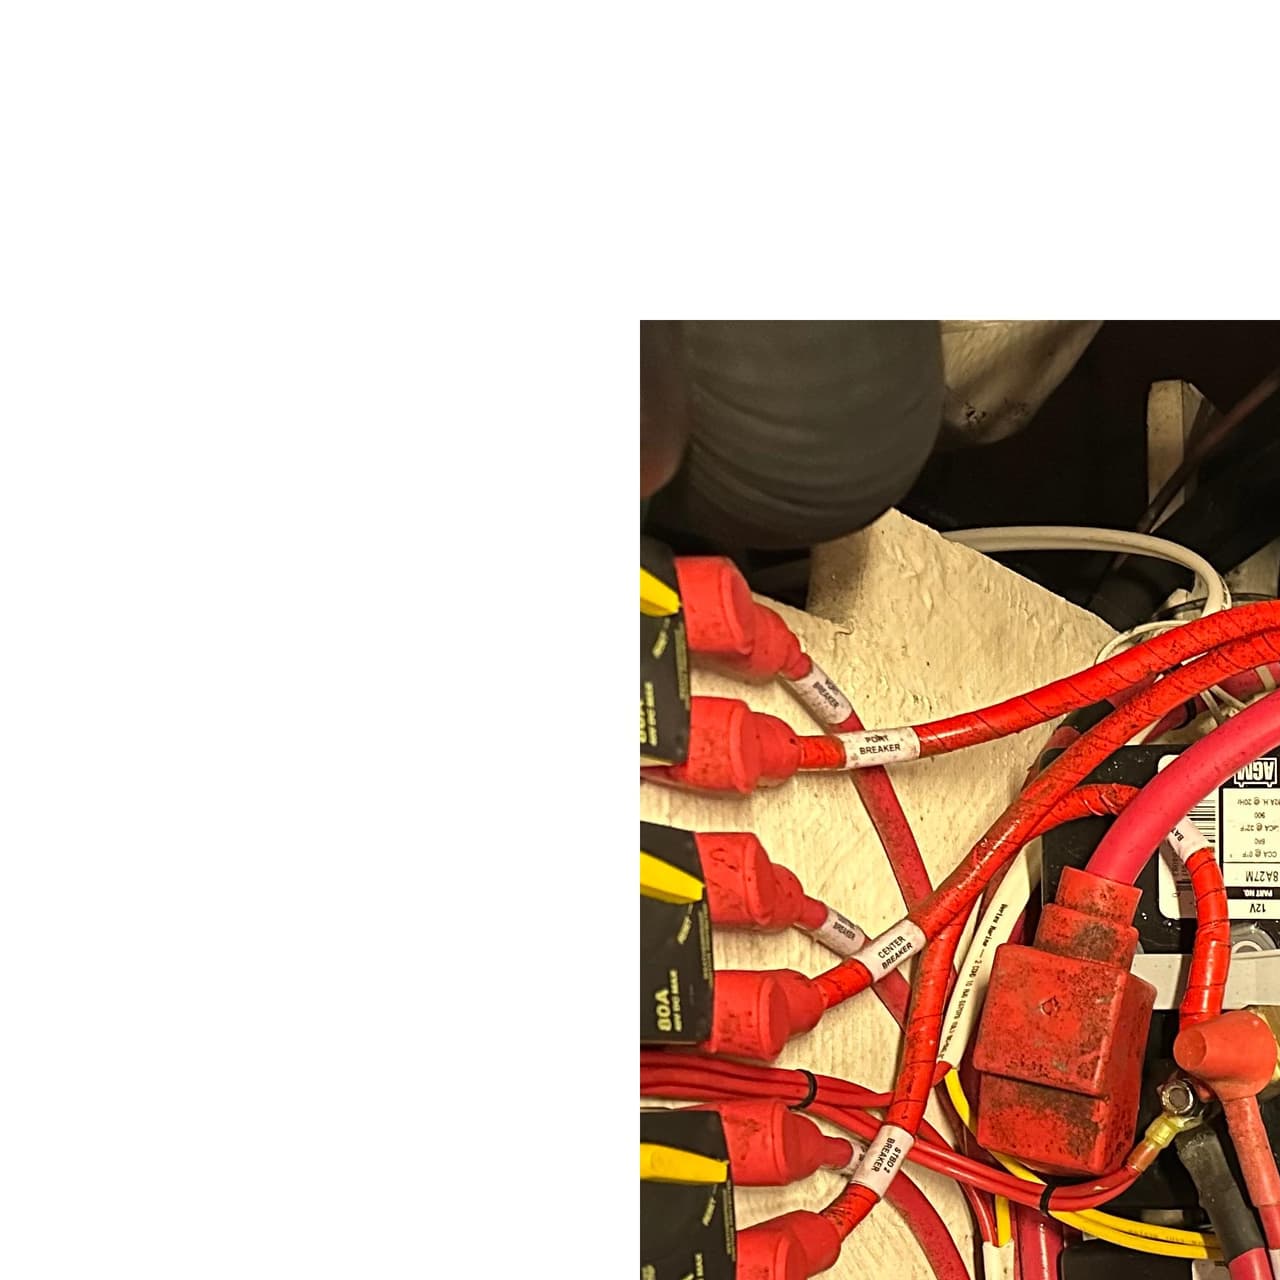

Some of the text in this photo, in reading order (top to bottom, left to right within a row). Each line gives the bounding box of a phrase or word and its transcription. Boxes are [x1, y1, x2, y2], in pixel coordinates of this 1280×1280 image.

[859, 744, 900, 754] BREAKER
[1236, 761, 1274, 781] AGM
[1171, 829, 1184, 841] BAT
[1245, 871, 1279, 881] 8A27M
[1250, 904, 1266, 912] 12V
[878, 935, 906, 958] CENTER
[881, 943, 913, 970] BREAKER
[871, 1138, 895, 1172] BREAKER
[695, 1253, 703, 1276] MAX
